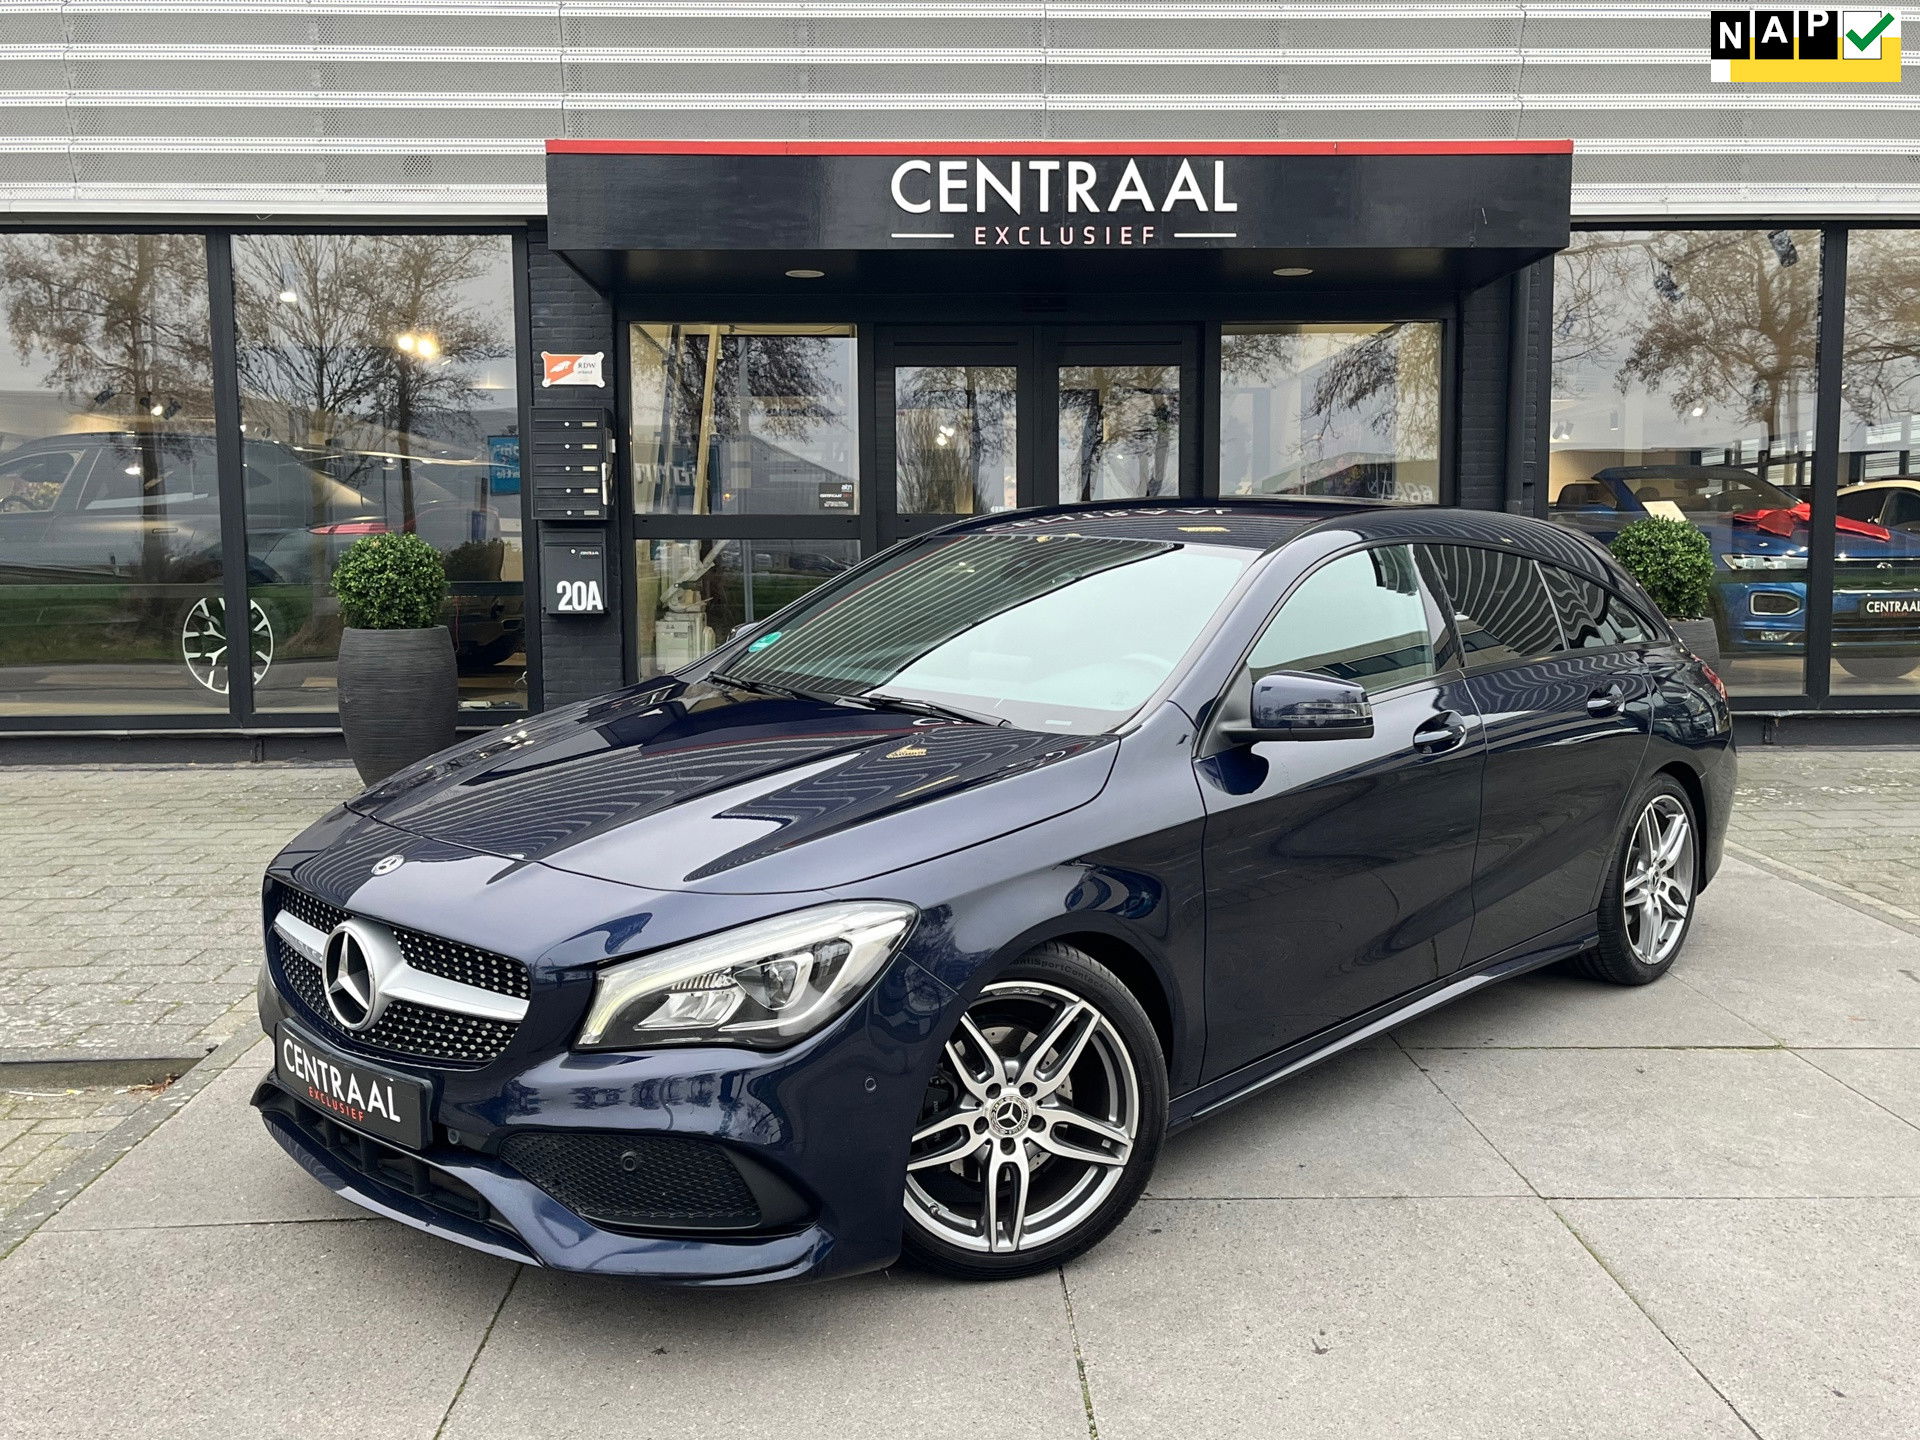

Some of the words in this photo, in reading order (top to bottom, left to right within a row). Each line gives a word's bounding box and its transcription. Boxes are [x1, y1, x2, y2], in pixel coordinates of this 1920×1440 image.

[890, 157, 1238, 216] CENTRAAL
[974, 226, 1155, 246] EXCLUSIEF
[556, 580, 604, 611] 20A
[283, 1038, 401, 1123] CENTRAAL
[308, 1085, 365, 1122] EXCLUSIEF
